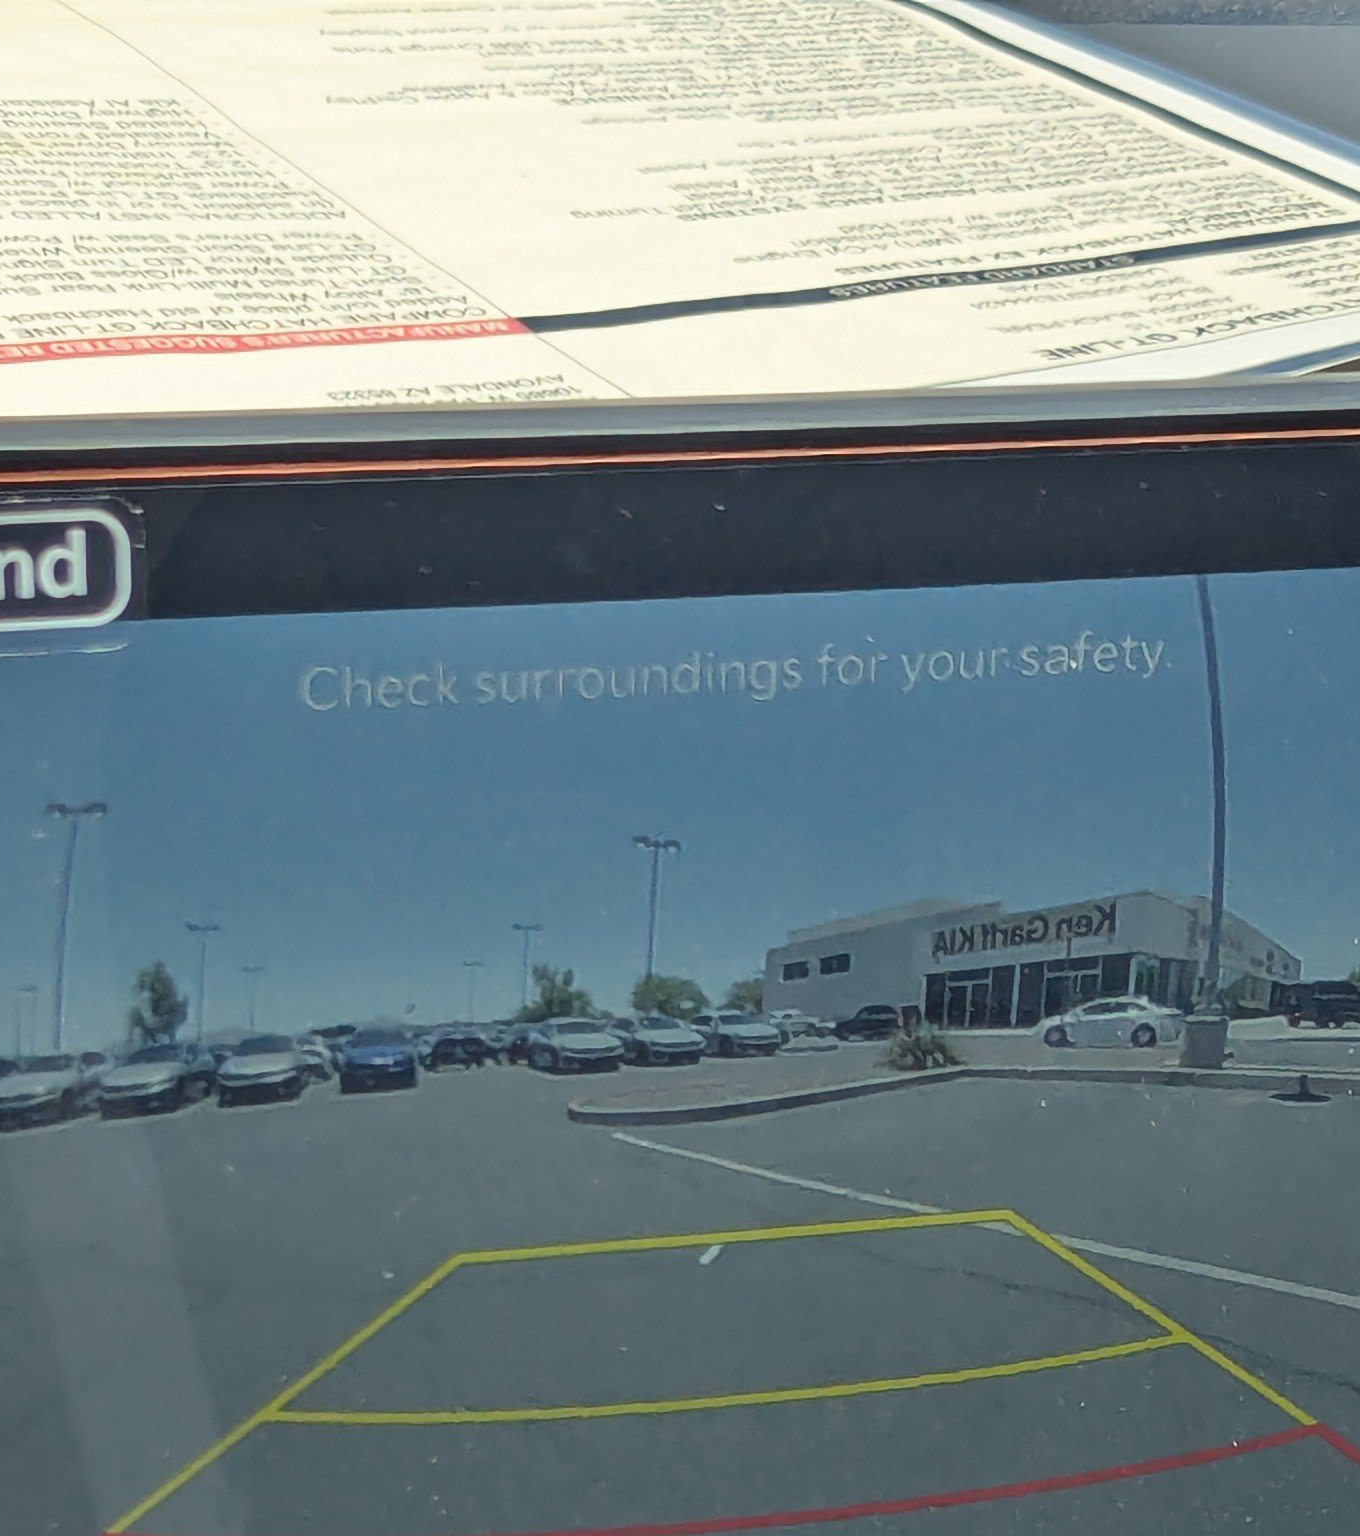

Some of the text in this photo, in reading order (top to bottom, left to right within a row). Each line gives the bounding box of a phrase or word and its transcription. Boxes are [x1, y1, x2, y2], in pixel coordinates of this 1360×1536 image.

[6, 271, 84, 282] Black
[50, 283, 116, 293] Rear
[213, 292, 319, 302] Wheels
[2, 307, 151, 324] Hatchback
[337, 306, 487, 323] COMPARE
[144, 317, 330, 332] HATCHBACK
[436, 374, 564, 394] AVONDALE
[300, 630, 1172, 712] Check surroundings for your safety.
